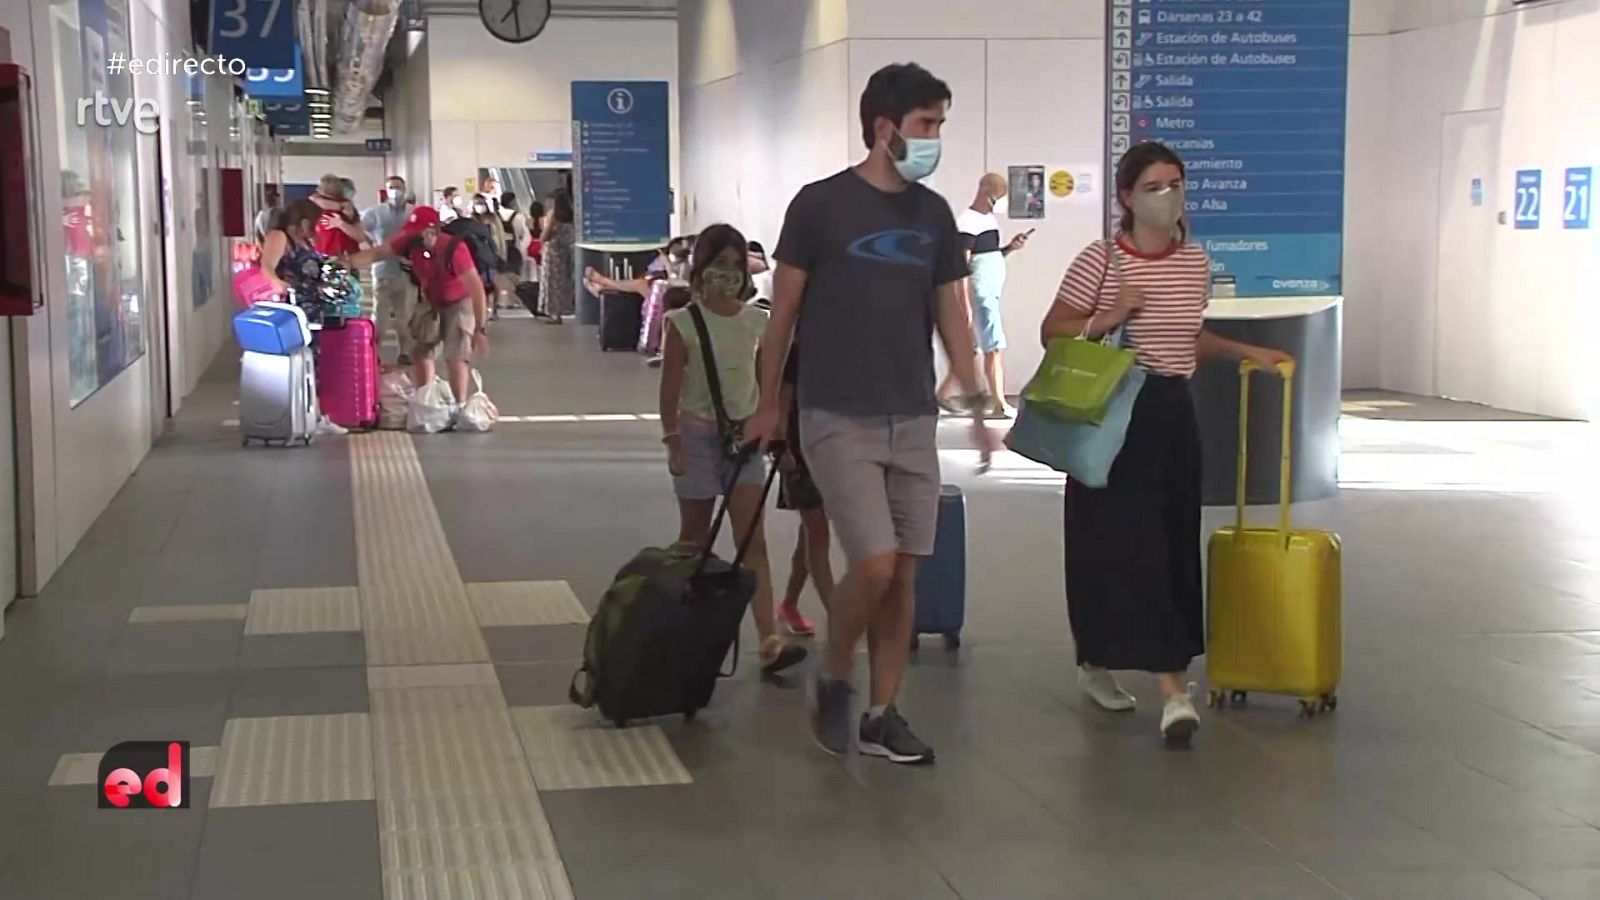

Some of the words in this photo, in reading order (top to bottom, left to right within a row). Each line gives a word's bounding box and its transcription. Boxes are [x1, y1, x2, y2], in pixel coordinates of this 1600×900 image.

[219, 0, 282, 38] 37
[1217, 10, 1232, 22] 23
[1236, 13, 1244, 22] a
[1247, 10, 1263, 22] 42
[1156, 31, 1208, 44] Estación
[1211, 32, 1228, 43] de
[1230, 32, 1297, 44] Autobuses
[1156, 52, 1207, 65] Estación
[1210, 53, 1228, 64] de
[1230, 53, 1297, 65] Autobuses
[1155, 74, 1194, 86] Salida
[1155, 95, 1194, 107] Salida
[1156, 117, 1195, 129] Metro
[1202, 178, 1248, 190] Avanza
[1202, 198, 1228, 210] Alsa
[1516, 186, 1539, 221] 22
[1563, 185, 1588, 221] 21
[1206, 239, 1269, 252] fumadores
